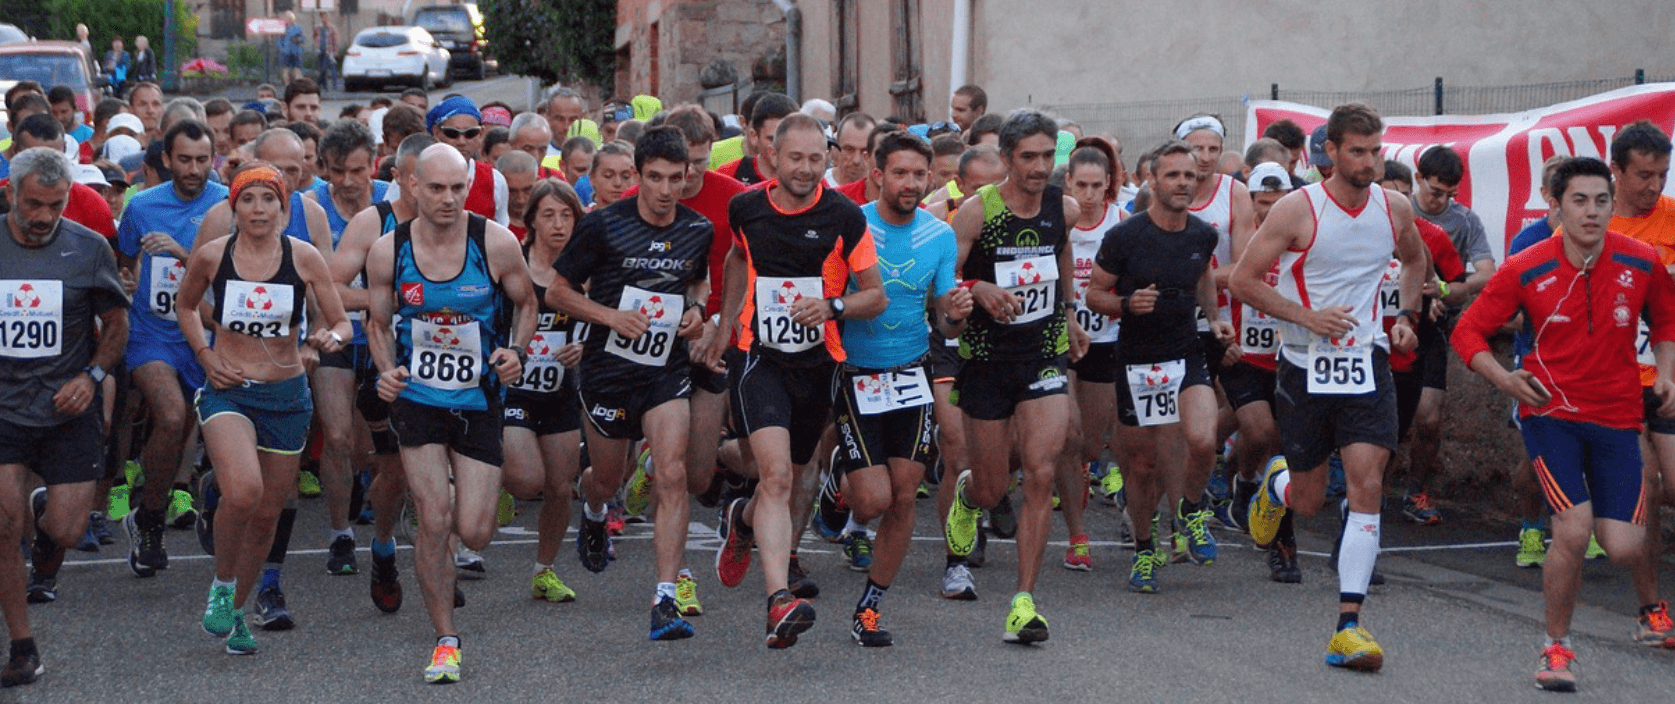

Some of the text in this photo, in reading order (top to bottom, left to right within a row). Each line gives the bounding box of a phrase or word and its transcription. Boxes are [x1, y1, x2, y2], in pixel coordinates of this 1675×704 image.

[621, 257, 694, 270] BROOKS
[156, 291, 177, 315] 9
[0, 320, 57, 349] 1290
[762, 315, 820, 344] 1296
[1074, 309, 1103, 332] 03
[1245, 326, 1279, 349] 89
[417, 350, 475, 383] 868
[1313, 355, 1367, 386] 955
[1138, 390, 1177, 418] 795
[841, 422, 862, 460] SKINS
